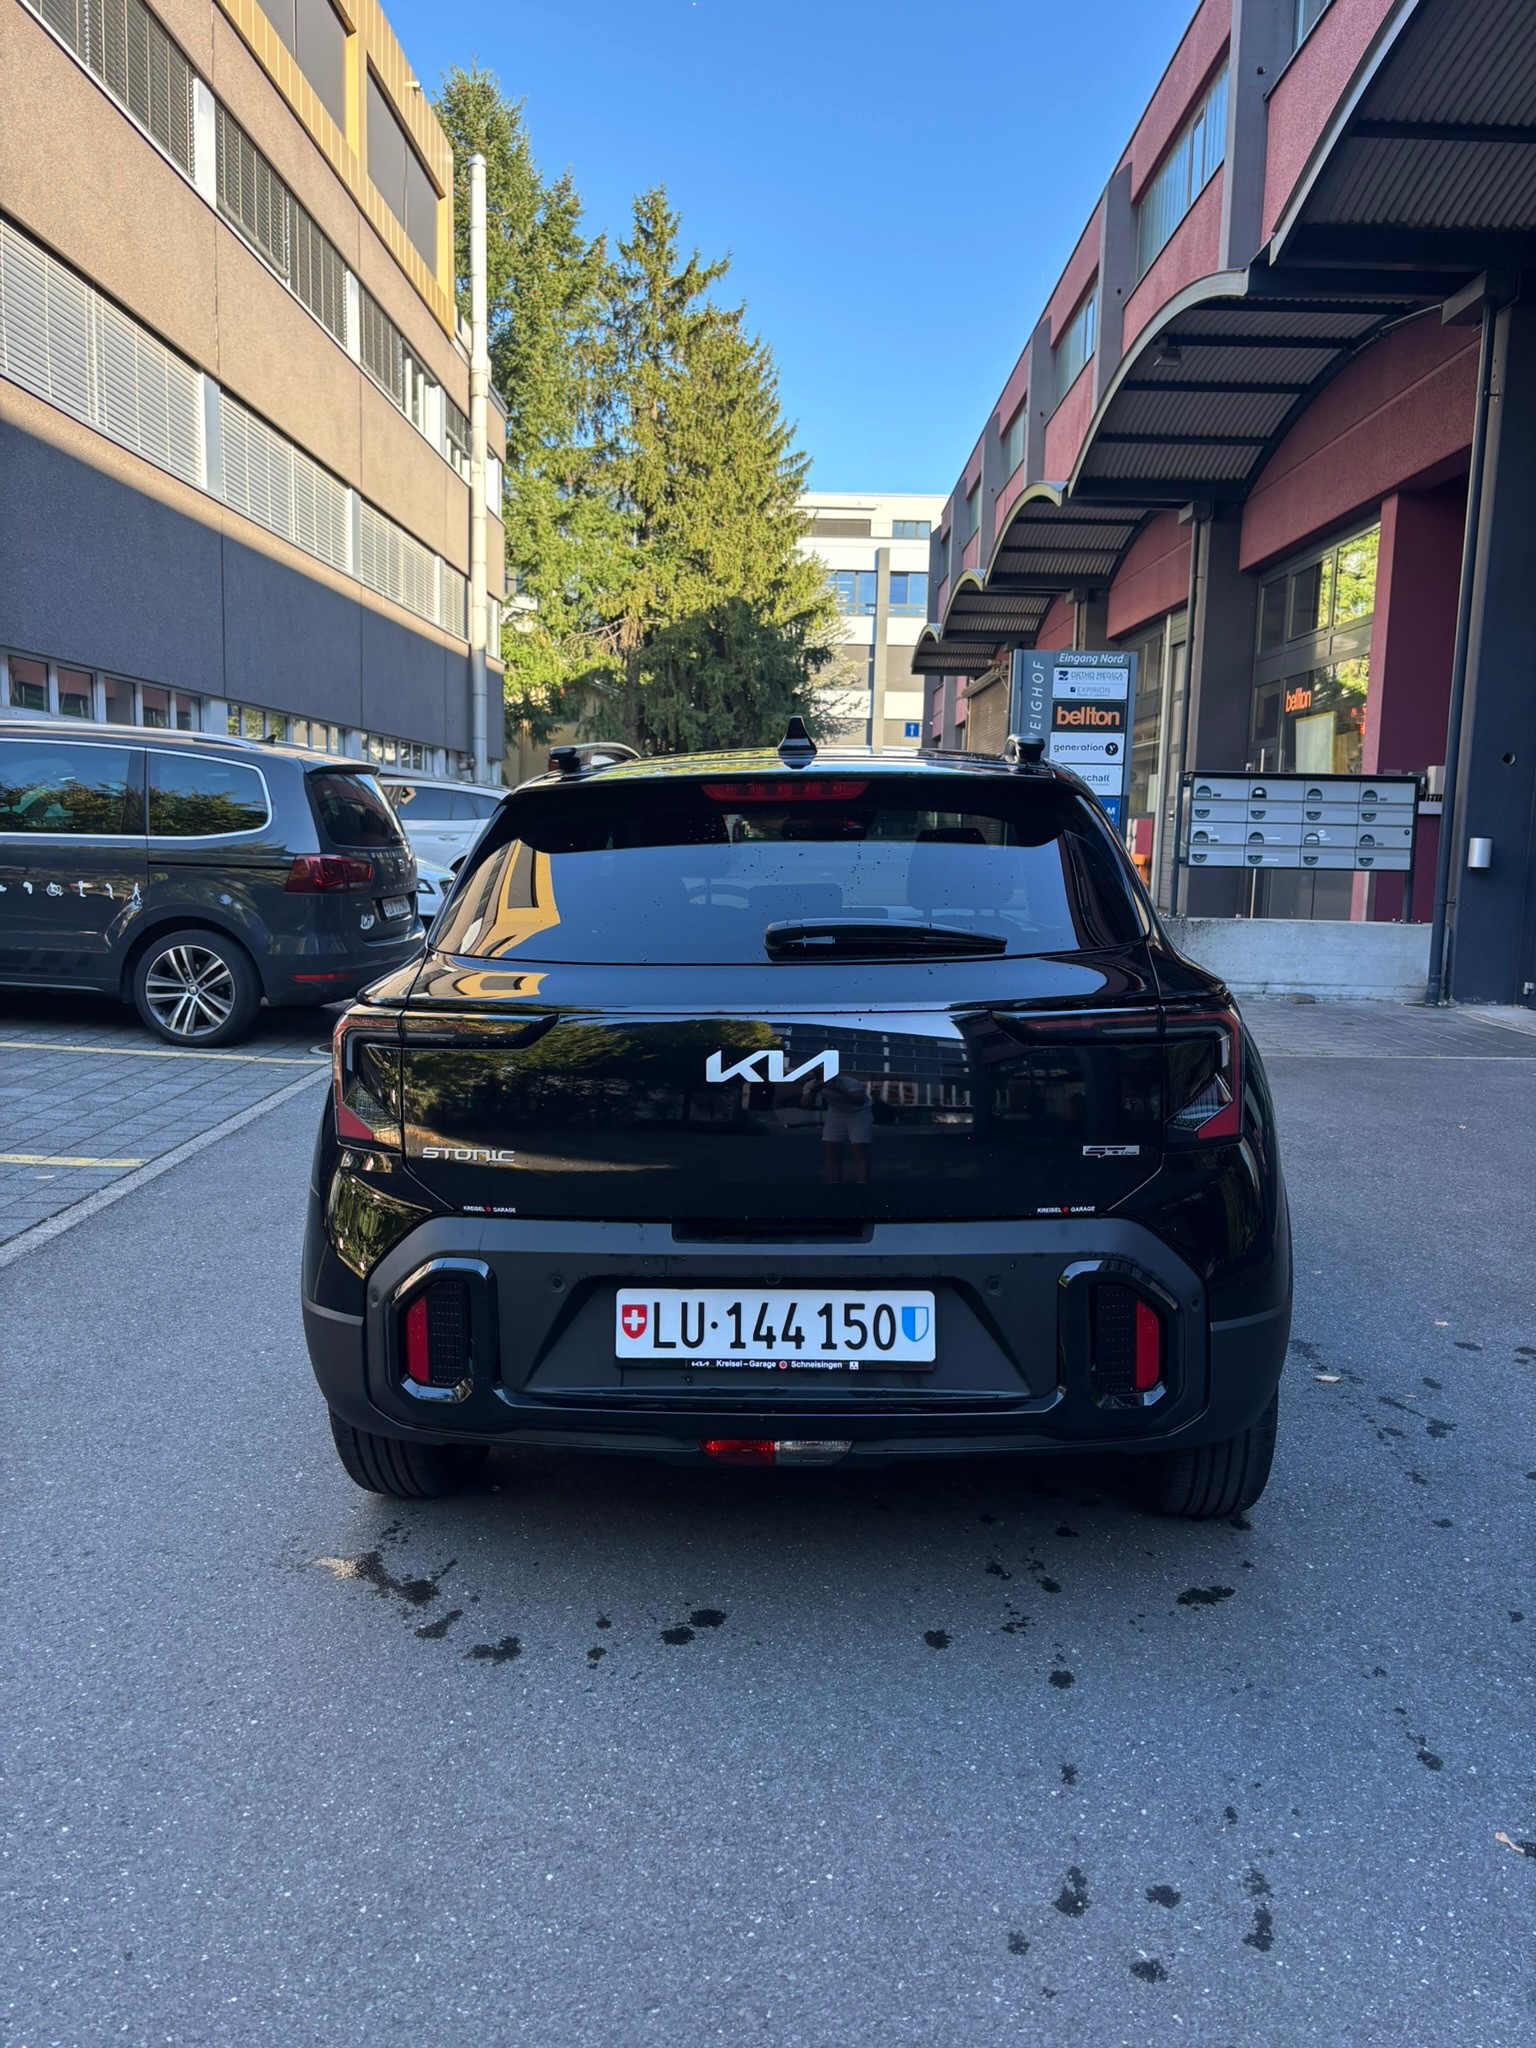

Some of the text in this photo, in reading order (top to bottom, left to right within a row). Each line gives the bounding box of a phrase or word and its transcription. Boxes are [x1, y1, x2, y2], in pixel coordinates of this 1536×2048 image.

[1059, 653, 1124, 665] Eingang Nord
[1077, 686, 1111, 694] EXPIRION
[1056, 706, 1120, 726] bellton
[1053, 743, 1104, 753] generation
[706, 1050, 839, 1082] KIA
[422, 1147, 516, 1163] STONIC
[791, 1360, 843, 1370] Schneisingen
